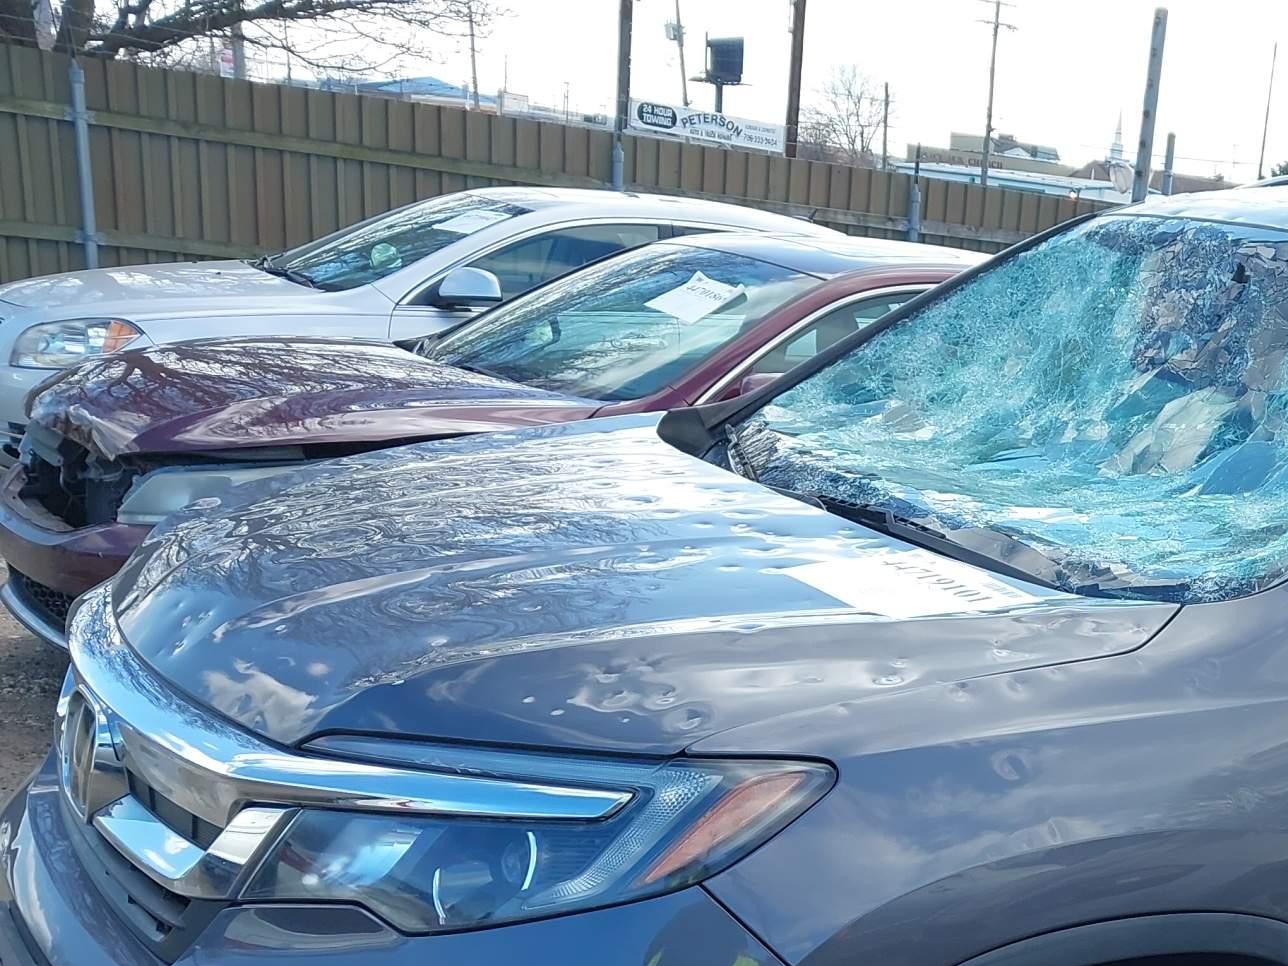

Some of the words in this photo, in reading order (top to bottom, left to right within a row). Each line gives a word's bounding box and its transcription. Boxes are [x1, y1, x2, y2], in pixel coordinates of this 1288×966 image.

[642, 113, 672, 126] TOWING
[643, 103, 652, 113] 24
[654, 106, 673, 117] HOUR
[681, 113, 743, 137] PETERSON
[882, 559, 993, 603] 44719101
